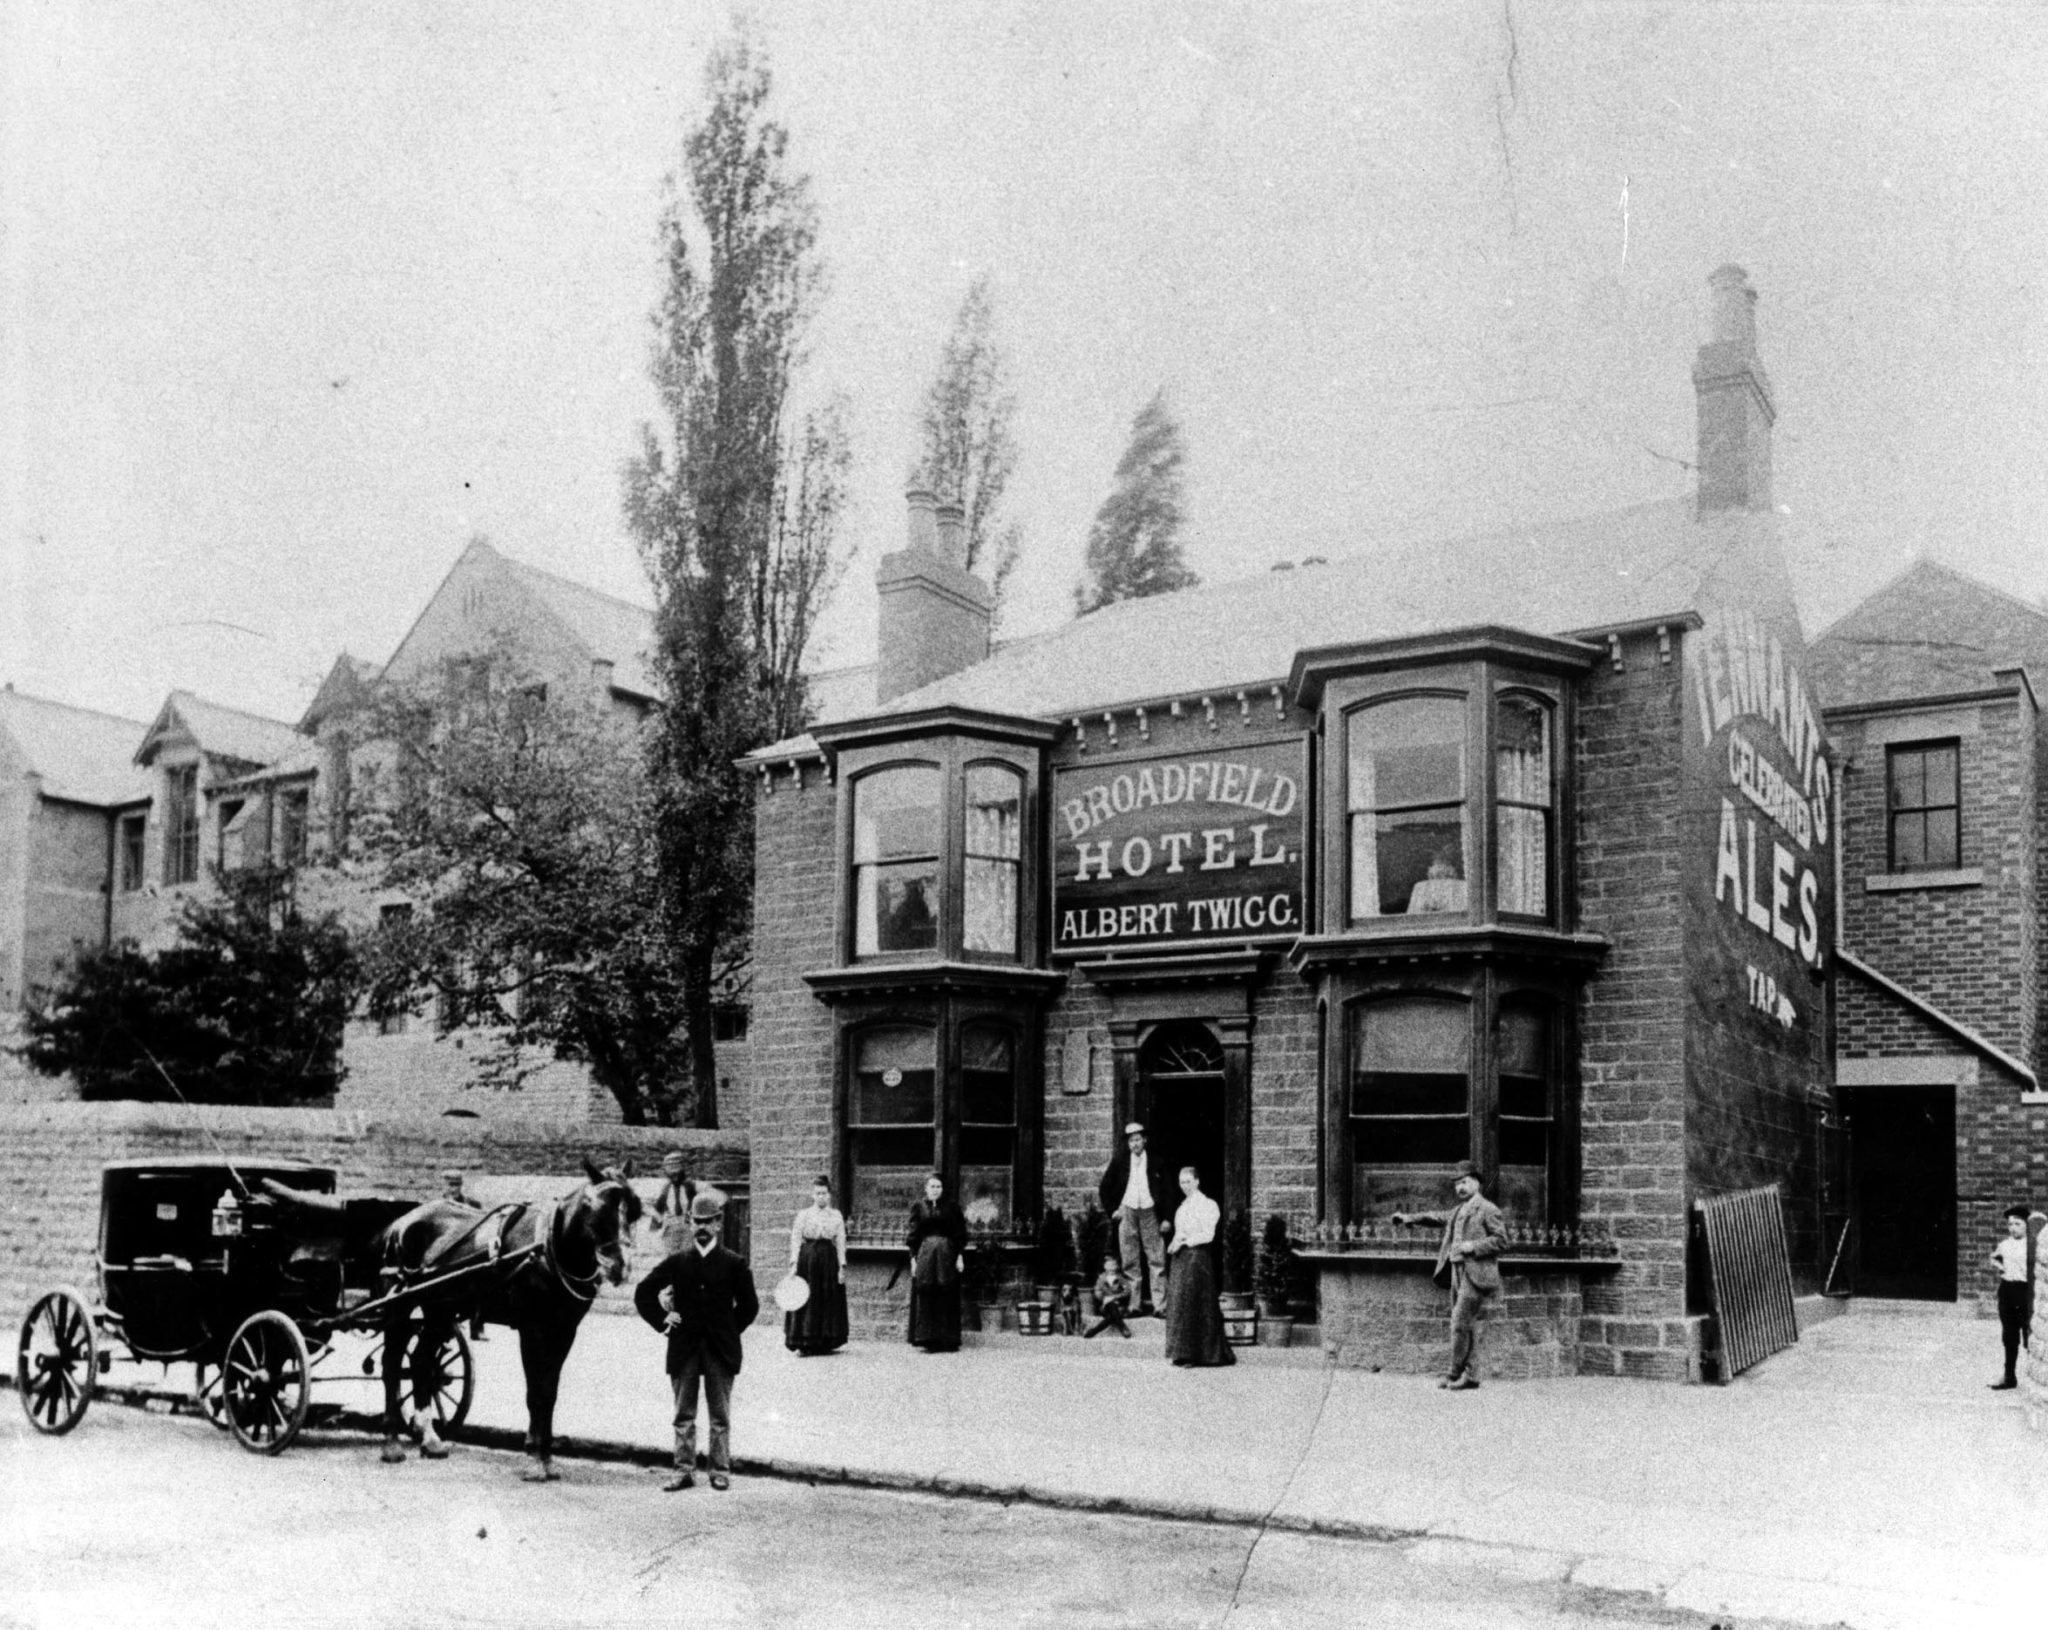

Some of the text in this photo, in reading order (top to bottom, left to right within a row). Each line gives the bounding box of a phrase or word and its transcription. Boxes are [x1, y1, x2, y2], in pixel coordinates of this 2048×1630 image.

[1060, 762, 1297, 838] BROADFIELD
[1074, 824, 1297, 881] HOTEL.
[1715, 796, 1823, 969] ALES.
[1060, 894, 1299, 940] ALBERT TWIGG.
[1746, 965, 1776, 1014] TAP
